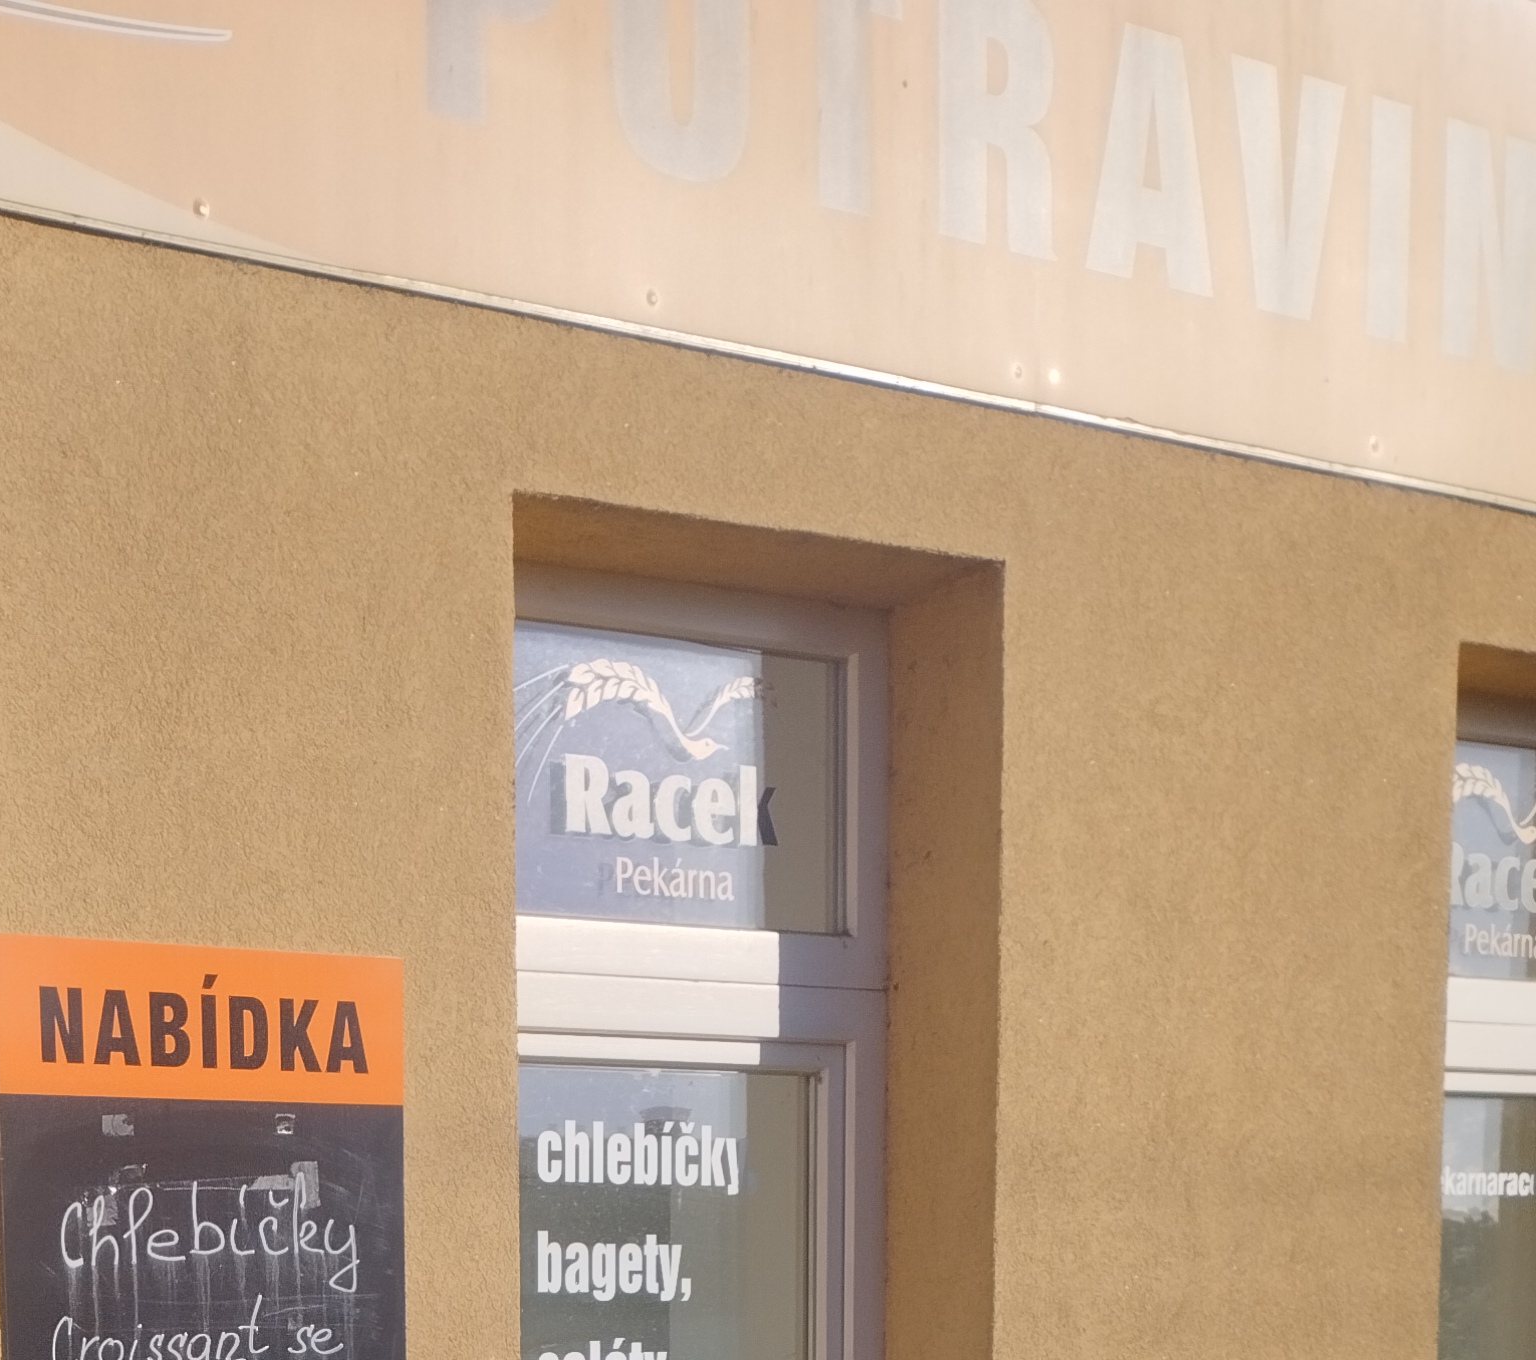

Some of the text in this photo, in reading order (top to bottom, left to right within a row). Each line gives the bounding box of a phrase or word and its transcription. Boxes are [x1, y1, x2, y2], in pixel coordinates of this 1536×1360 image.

[564, 753, 779, 847] Racek
[615, 855, 735, 902] Pekárna
[1464, 922, 1536, 959] Pekárn
[38, 973, 369, 1075] NABÍDKA
[536, 1230, 693, 1302] bagety,
[287, 1322, 345, 1356] se
